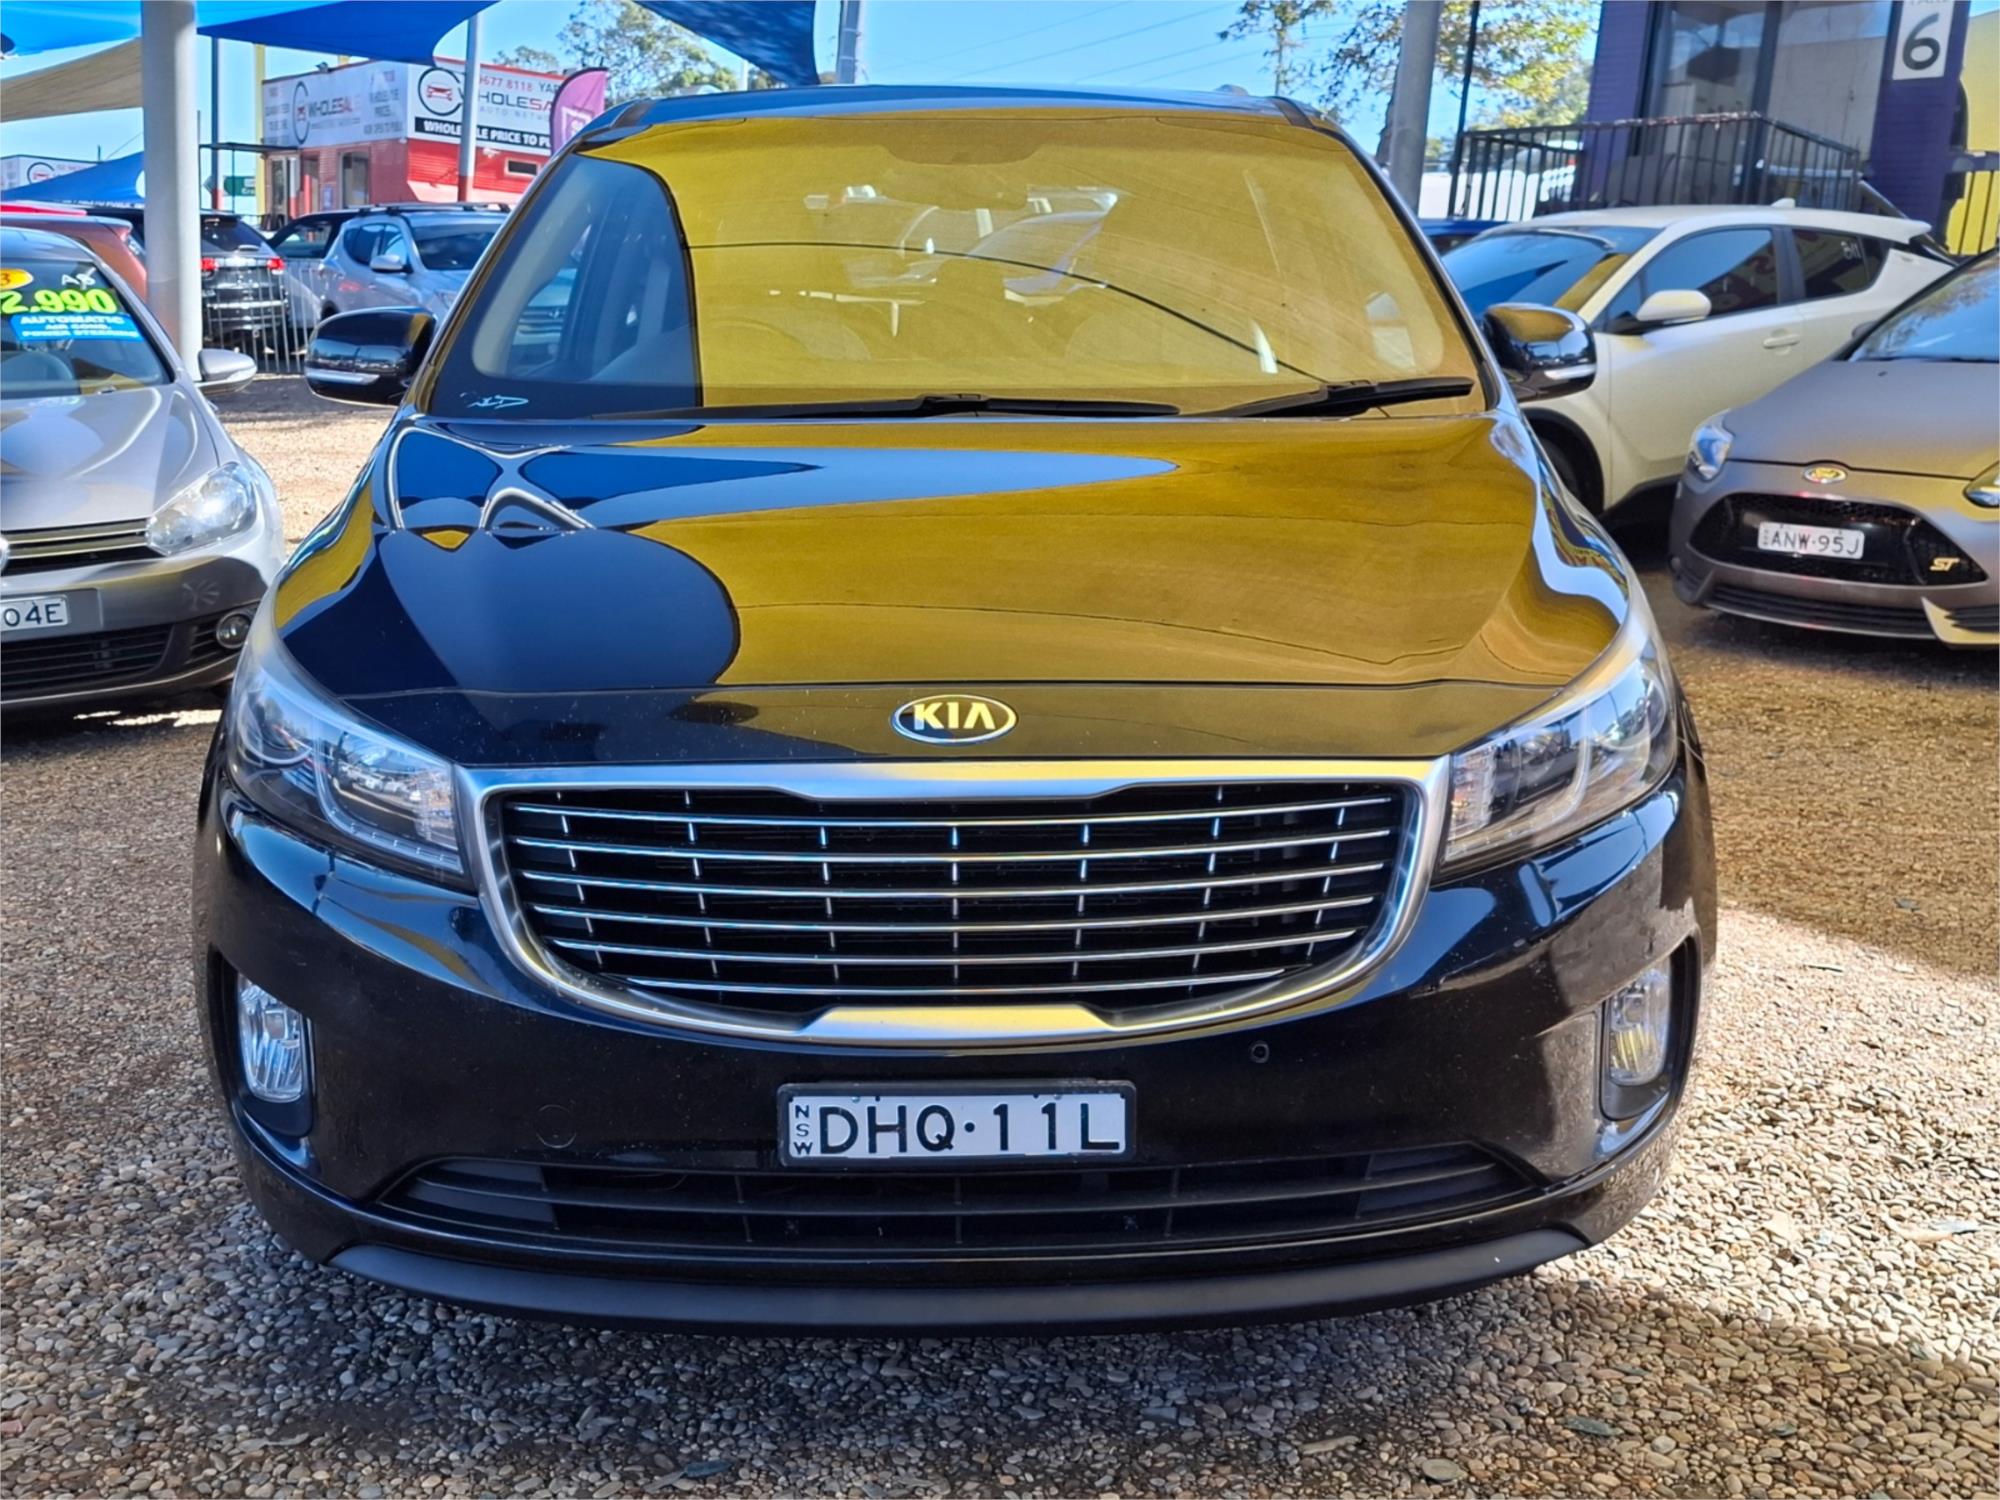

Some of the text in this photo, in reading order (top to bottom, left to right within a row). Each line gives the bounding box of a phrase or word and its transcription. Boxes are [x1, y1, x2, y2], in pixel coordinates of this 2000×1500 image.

[1902, 12, 1940, 70] 6
[458, 88, 553, 112] HOLESA
[490, 130, 521, 143] PRICE
[522, 133, 537, 144] TO
[20, 315, 126, 325] AUTOMATIC
[1929, 557, 1960, 572] ST
[914, 702, 995, 730] KIA
[795, 1104, 813, 1155] NSW
